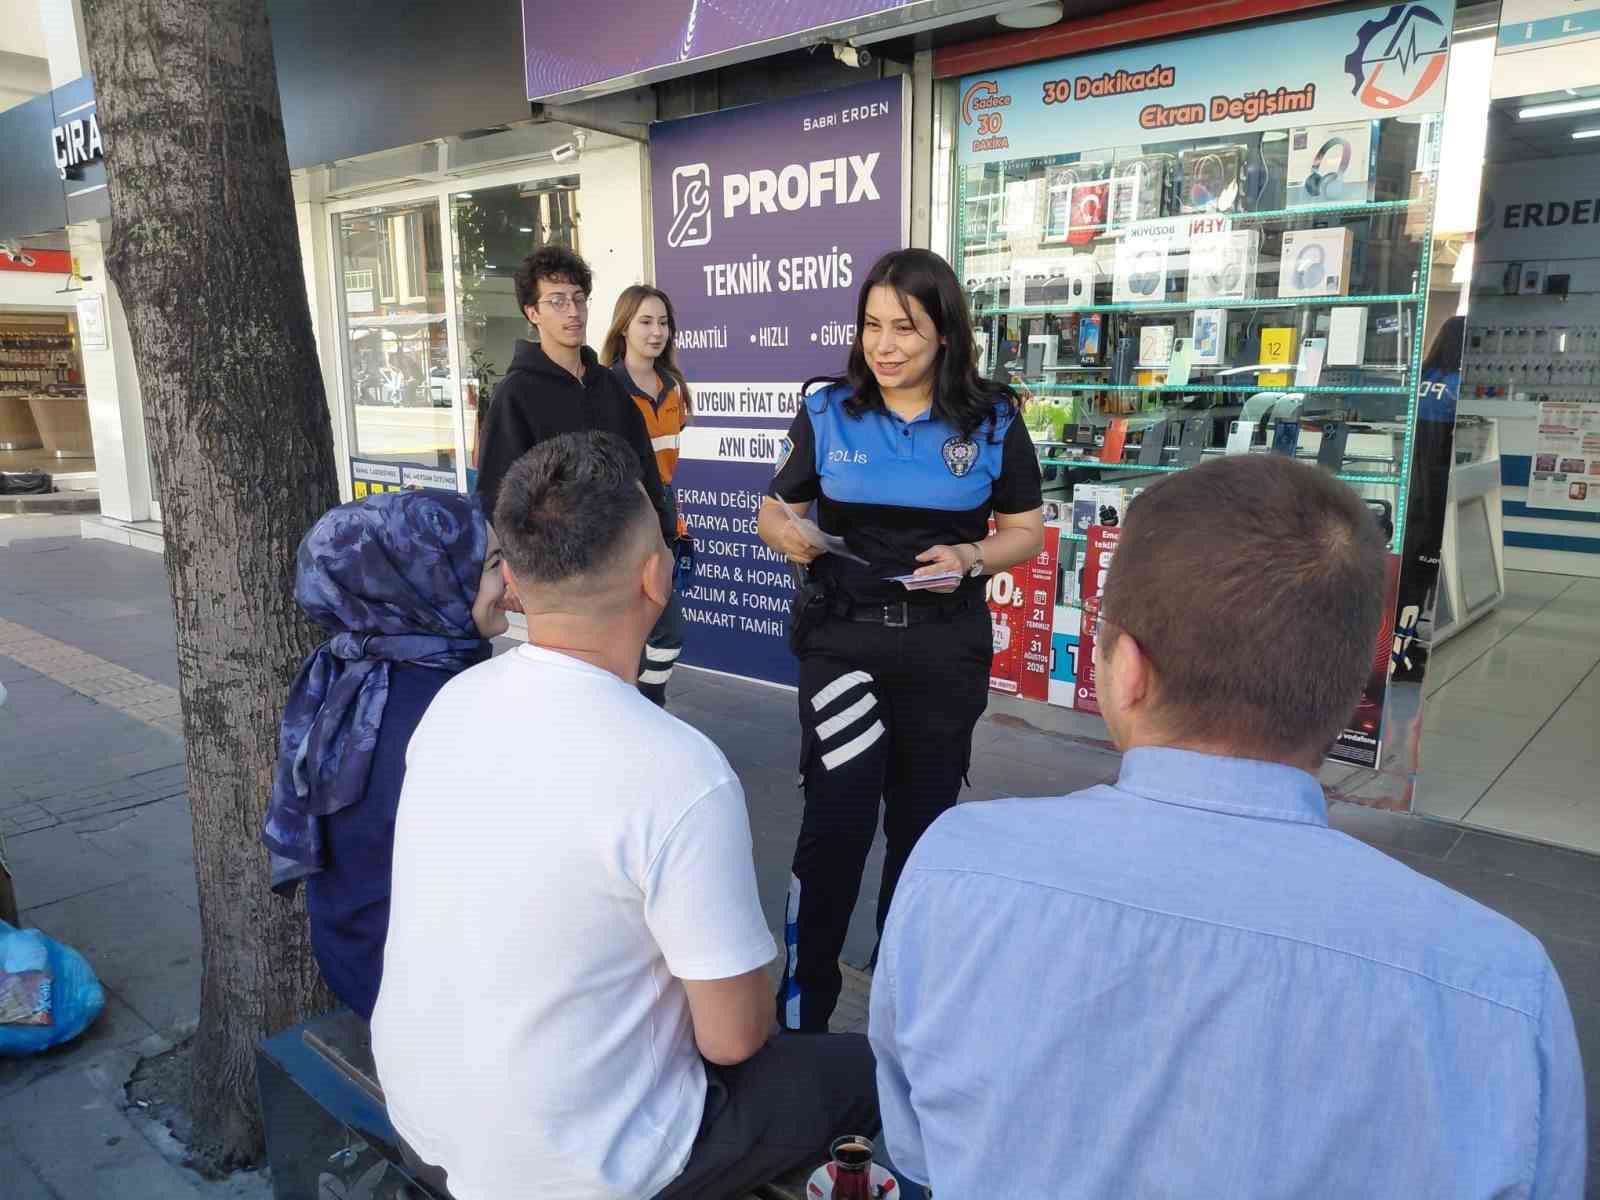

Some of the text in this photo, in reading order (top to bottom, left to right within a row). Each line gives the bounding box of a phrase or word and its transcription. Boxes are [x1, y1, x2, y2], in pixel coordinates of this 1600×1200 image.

[1043, 65, 1175, 106] 30 Dakikada
[842, 101, 889, 124] ERDEN
[973, 94, 1012, 111] Sadece
[1140, 83, 1316, 129] Ekran Değişimi
[977, 112, 1002, 135] 30
[52, 112, 104, 180] ÇIRA
[973, 136, 1009, 152] DAKİKA
[723, 152, 881, 218] PROFIX
[704, 246, 853, 297] TEKNİK SERVİS
[759, 326, 789, 347] HIZLI
[1267, 342, 1281, 356] 12
[697, 391, 735, 413] UYGUN
[740, 387, 773, 413] FİYAT
[718, 437, 745, 457] AYNI
[750, 433, 775, 458] GÜN
[677, 488, 764, 512] EKRAN DEĞİŞİ
[732, 516, 758, 535] DEĞ
[708, 540, 749, 558] SOKET
[695, 562, 730, 580] MERA
[733, 567, 744, 583] &
[728, 590, 739, 606] &
[681, 607, 783, 637] ANAKART TAMİRİ
[1033, 608, 1044, 621] 21
[1030, 640, 1041, 653] 31
